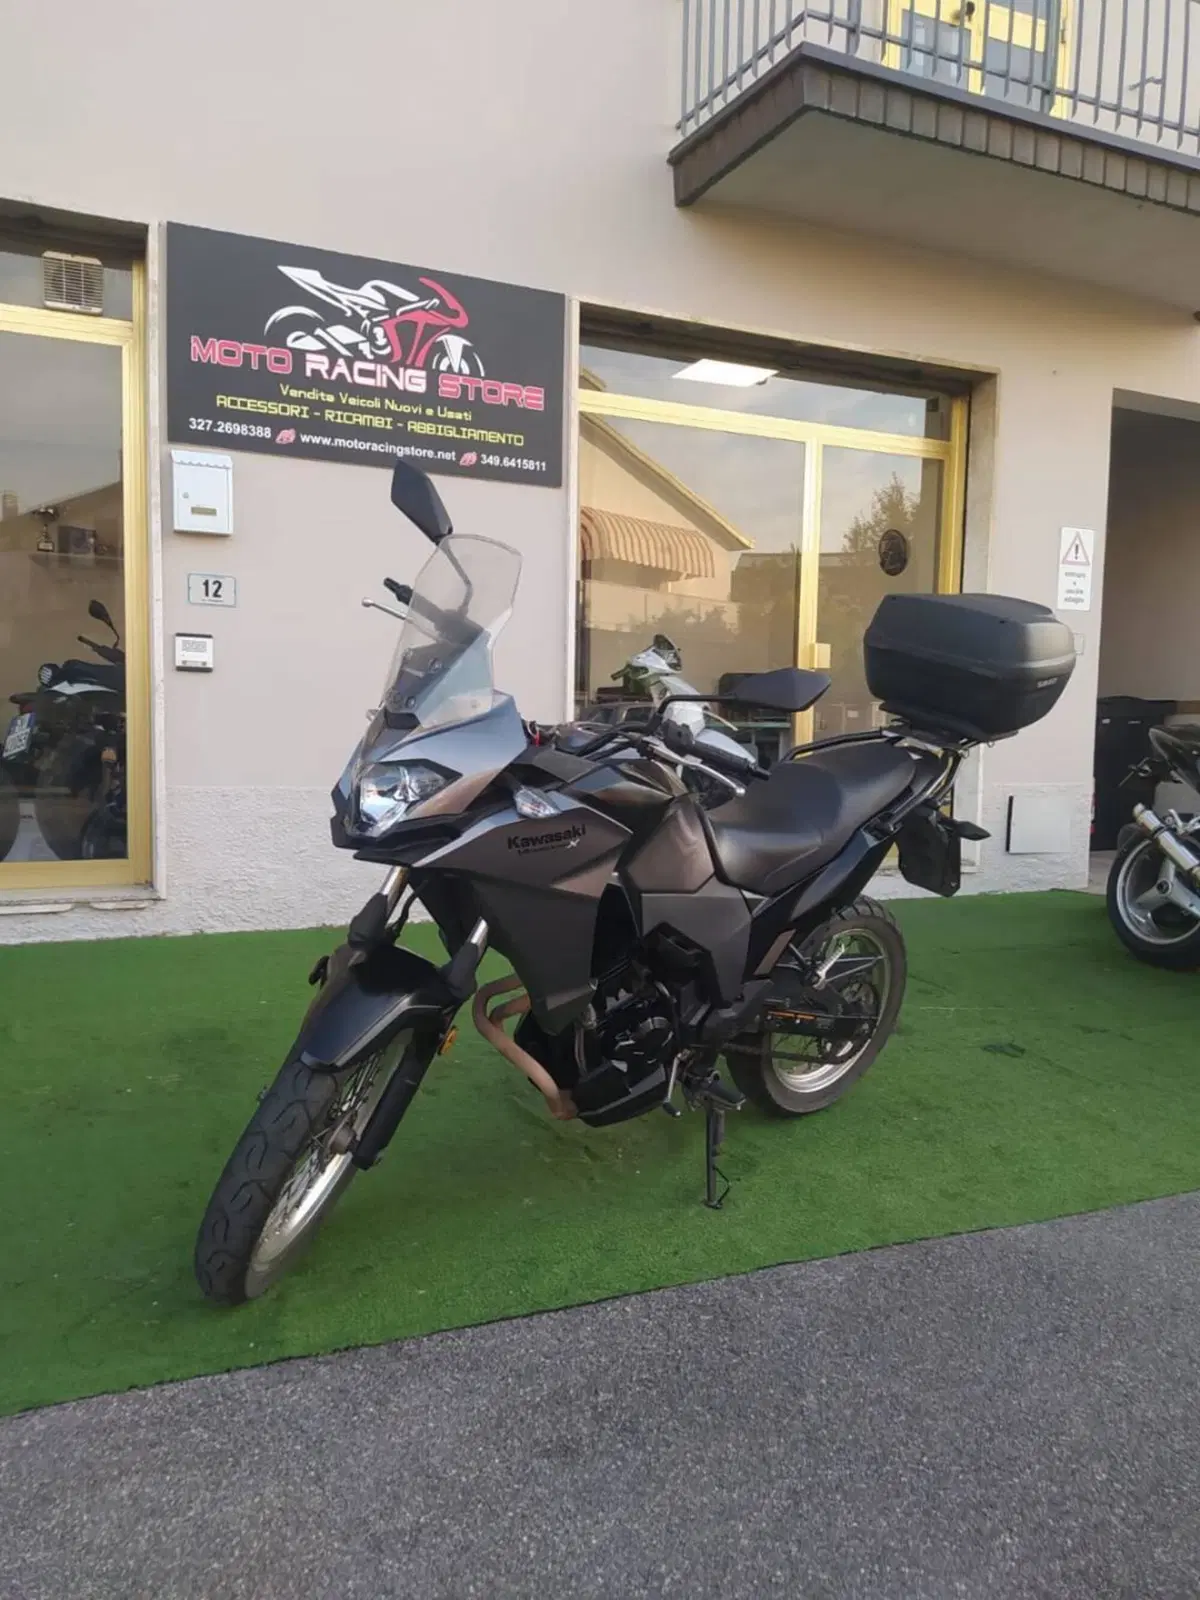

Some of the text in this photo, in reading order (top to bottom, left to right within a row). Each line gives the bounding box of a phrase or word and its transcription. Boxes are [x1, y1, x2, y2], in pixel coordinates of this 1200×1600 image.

[190, 335, 544, 411] MOTO RACING STORE
[216, 395, 310, 418] ACCESSORI
[324, 409, 393, 430] RICAMBI
[407, 420, 524, 447] ABBIGLIAMENTO
[339, 391, 381, 410] Veicoli
[384, 399, 422, 415] Nuovi
[425, 408, 434, 417] e
[437, 406, 472, 422] Usati
[188, 417, 546, 472] 327.2698388 www.motoracingstore.net 349.6415811
[202, 579, 222, 598] 12
[507, 824, 586, 850] Kawasaki
